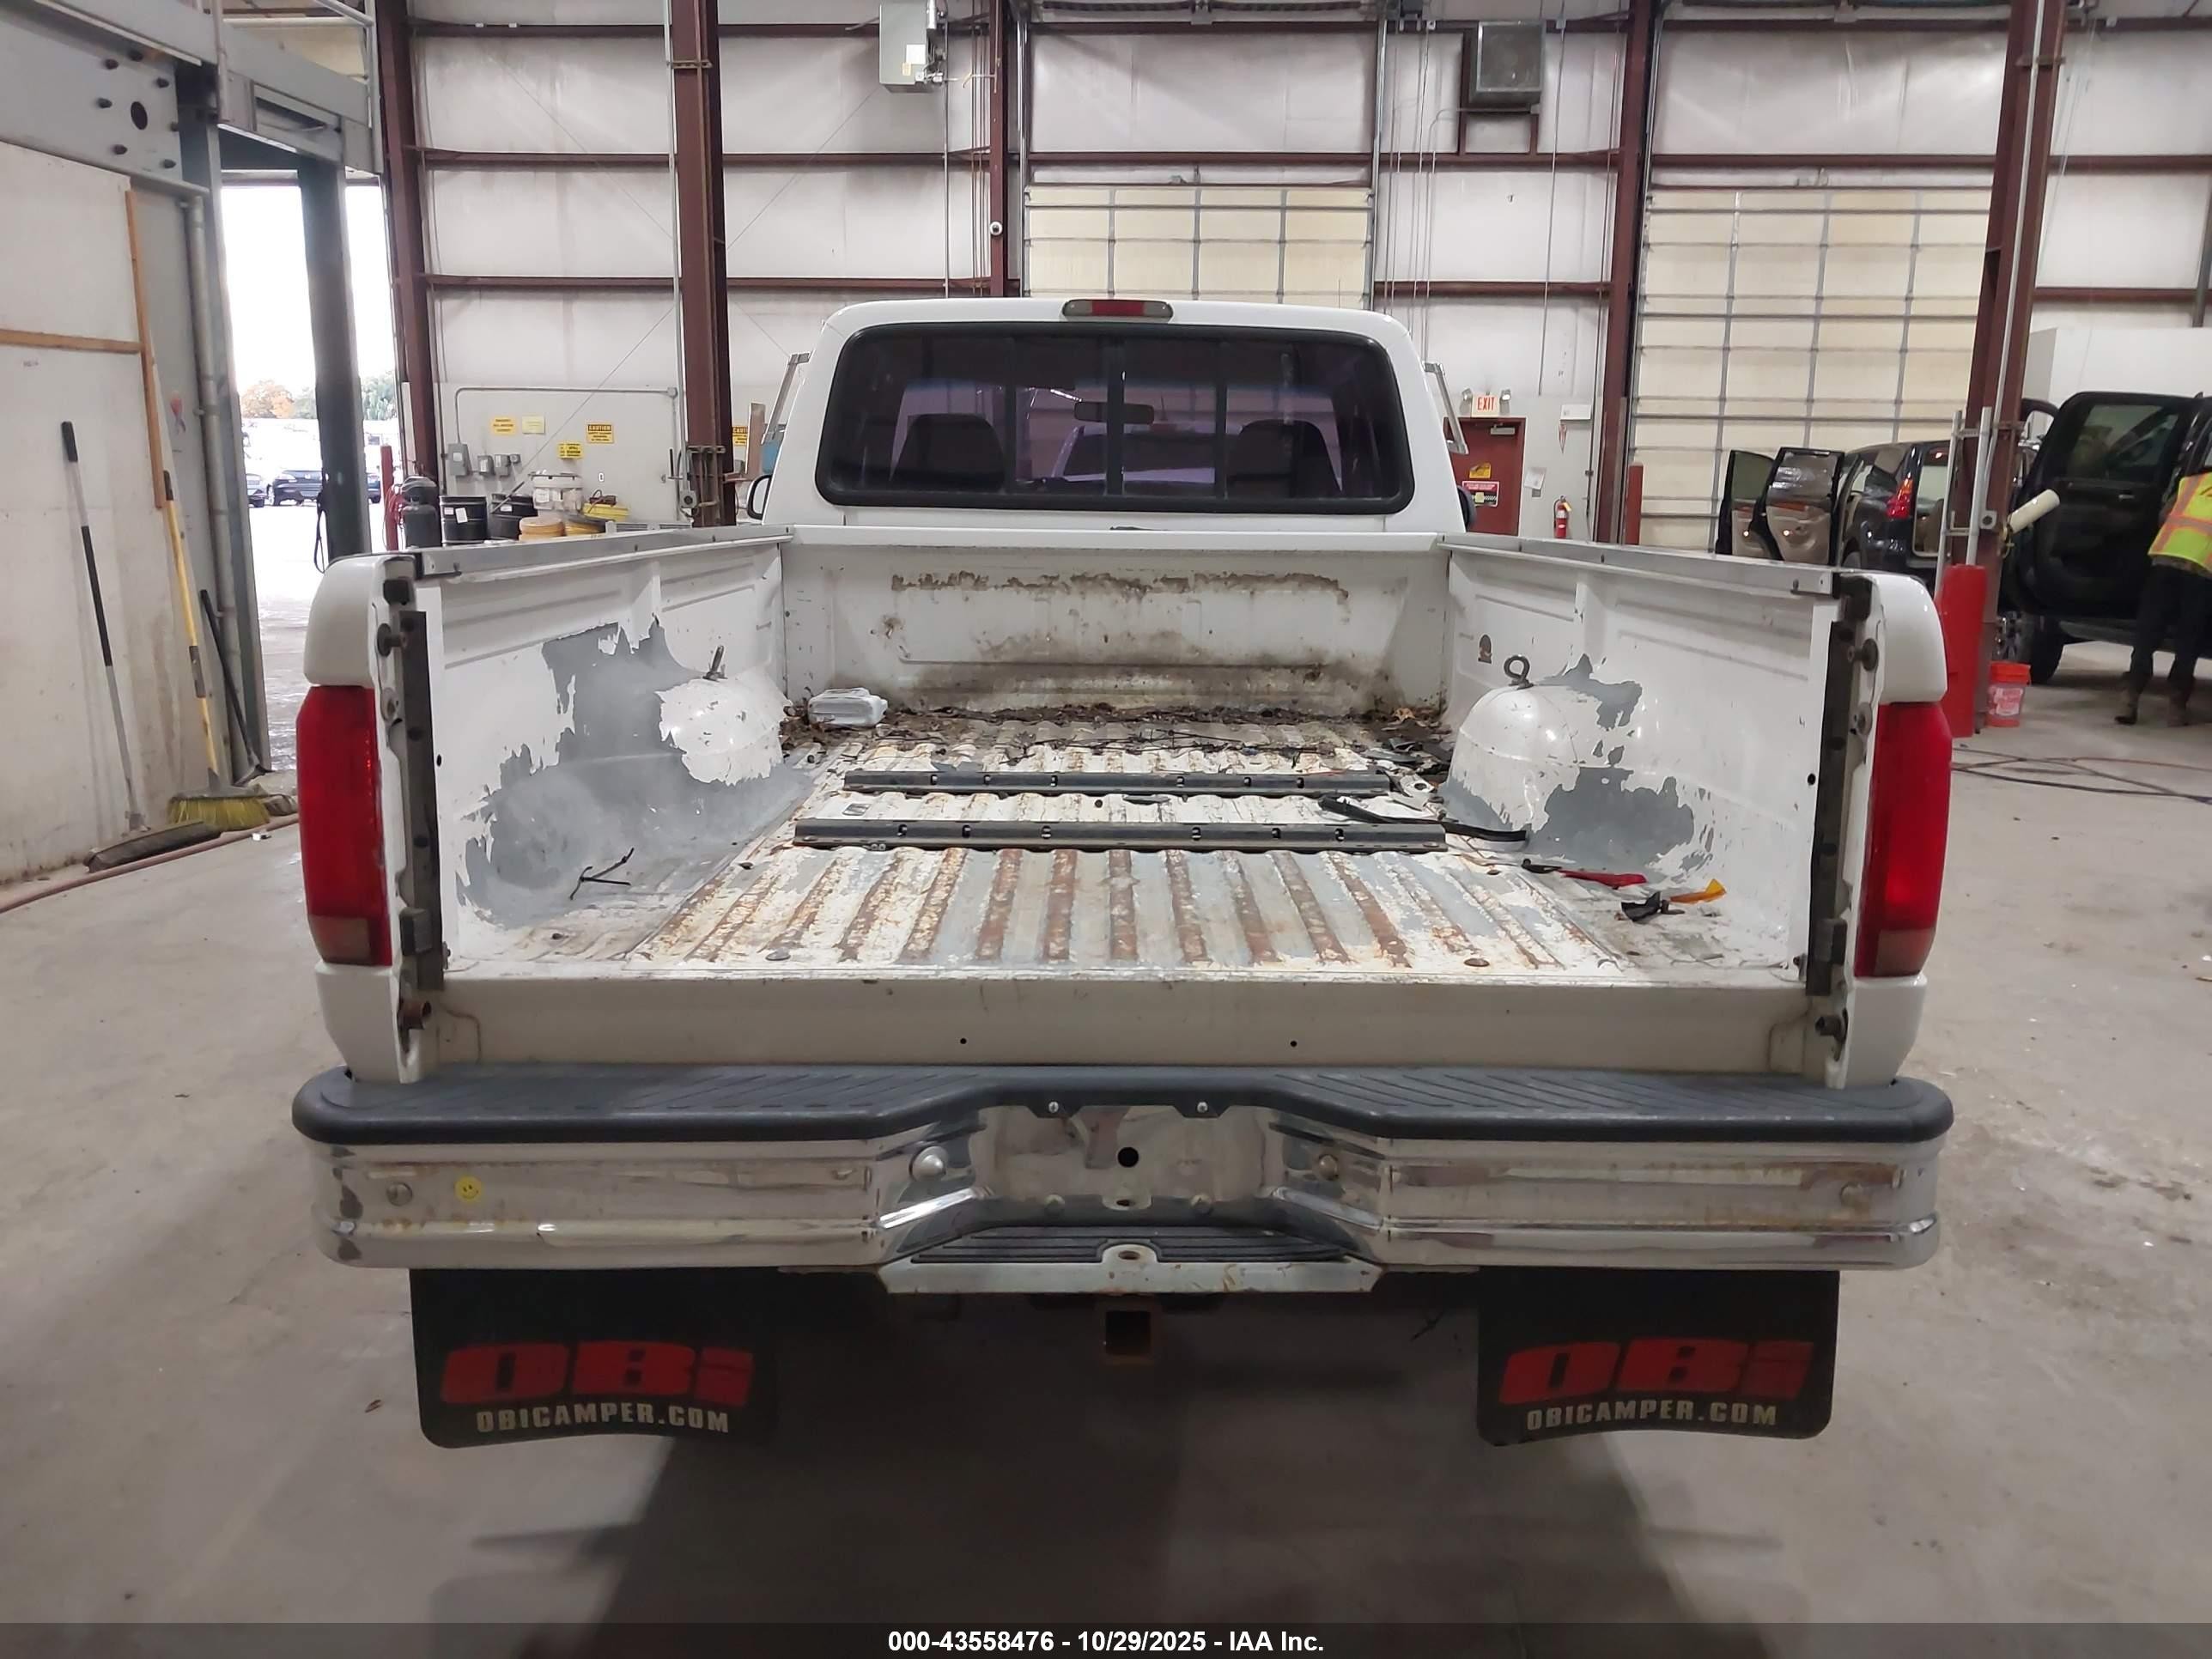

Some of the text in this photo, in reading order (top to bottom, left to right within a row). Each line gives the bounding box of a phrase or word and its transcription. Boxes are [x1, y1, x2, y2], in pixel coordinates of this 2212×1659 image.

[1477, 397, 1494, 410] EXIT
[476, 1402, 728, 1433] OBICAMPER.COM
[1526, 1399, 1777, 1431] OBICAMPER.COM
